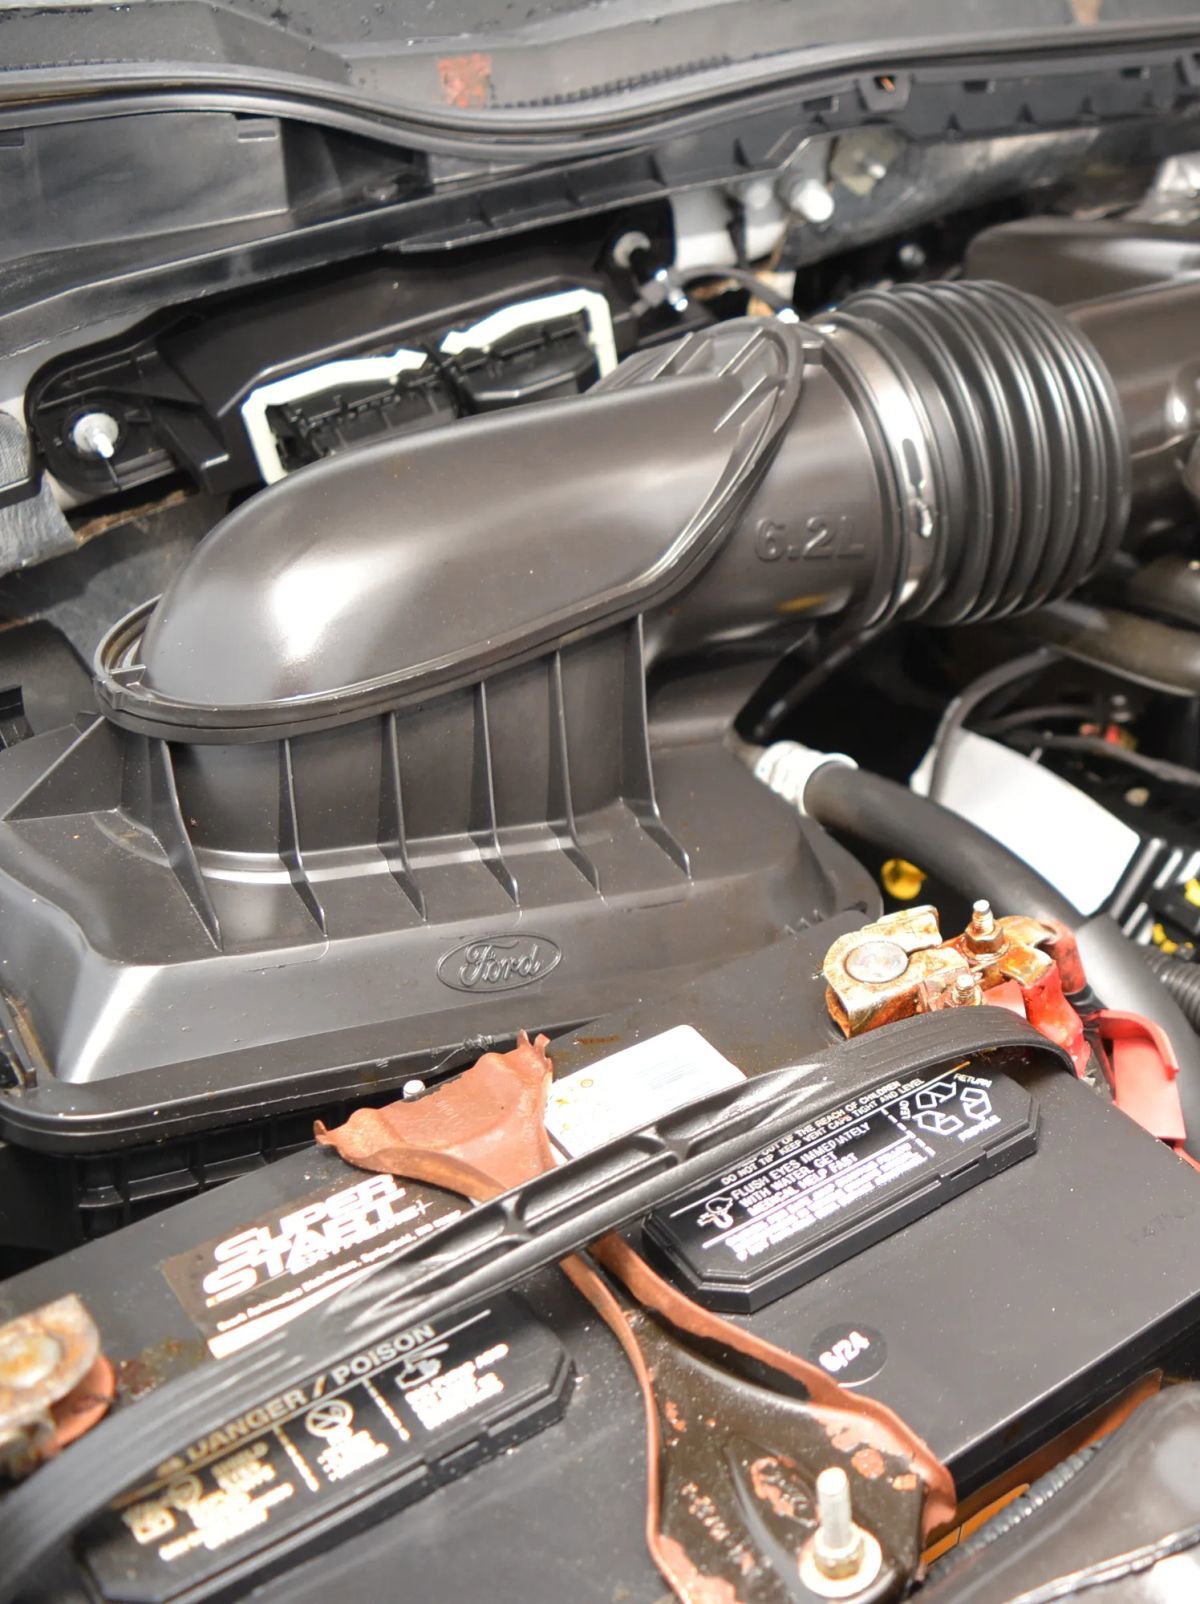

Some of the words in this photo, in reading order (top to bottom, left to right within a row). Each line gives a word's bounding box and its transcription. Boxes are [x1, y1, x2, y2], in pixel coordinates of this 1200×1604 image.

[755, 515, 865, 563] 6.2L
[459, 940, 541, 987] Ford
[720, 1173, 737, 1184] DO
[737, 1162, 757, 1176] NOT
[758, 1153, 773, 1165] TIP
[778, 1139, 801, 1155] KEEP
[802, 1126, 826, 1141] VENT
[827, 1114, 852, 1129] CAPS
[851, 1100, 877, 1116] TIGHT
[879, 1090, 898, 1102] AND
[897, 1078, 924, 1093] LEVEL
[780, 1133, 793, 1144] OF
[793, 1124, 815, 1136] THE
[814, 1109, 845, 1127] REACH
[844, 1101, 857, 1111] OF
[858, 1080, 901, 1107] CHILDREN
[899, 1100, 911, 1120] LEAD
[730, 1175, 770, 1199] FLUSH
[768, 1159, 800, 1179] EYES
[799, 1122, 869, 1163] IMMEDIATELY
[738, 1187, 771, 1207] WITH
[813, 1151, 837, 1168] GET
[747, 1186, 799, 1216] MEDICAL
[797, 1168, 827, 1189] HELP
[827, 1152, 857, 1173] FAST
[215, 1174, 398, 1272] SUPER
[330, 1324, 434, 1384] POISON
